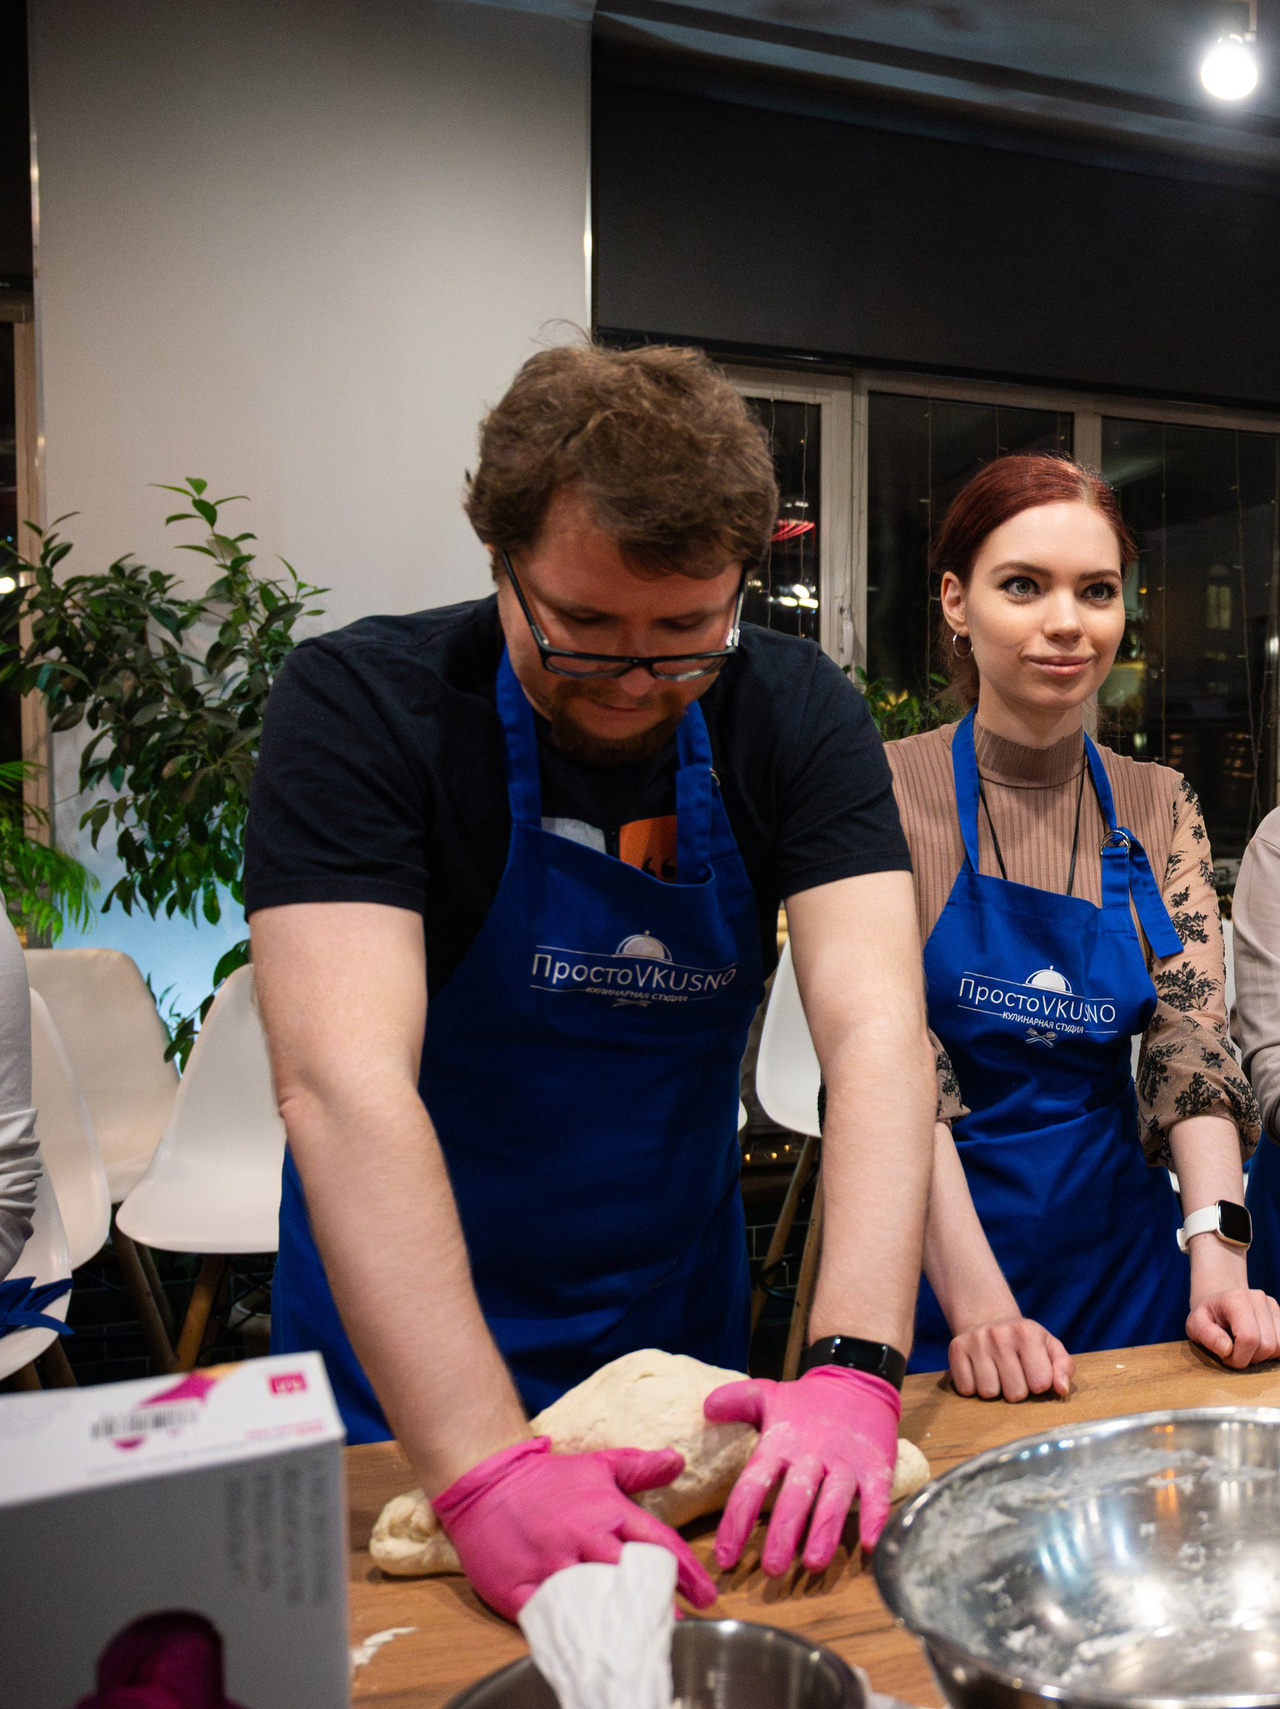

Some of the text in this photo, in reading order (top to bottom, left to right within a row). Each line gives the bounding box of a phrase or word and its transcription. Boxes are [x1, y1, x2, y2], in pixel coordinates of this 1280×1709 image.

[532, 953, 738, 992] ПростоVKUSNO
[1001, 1010, 1084, 1034] КУЛИНАРНАЯ СТУДИЯ
